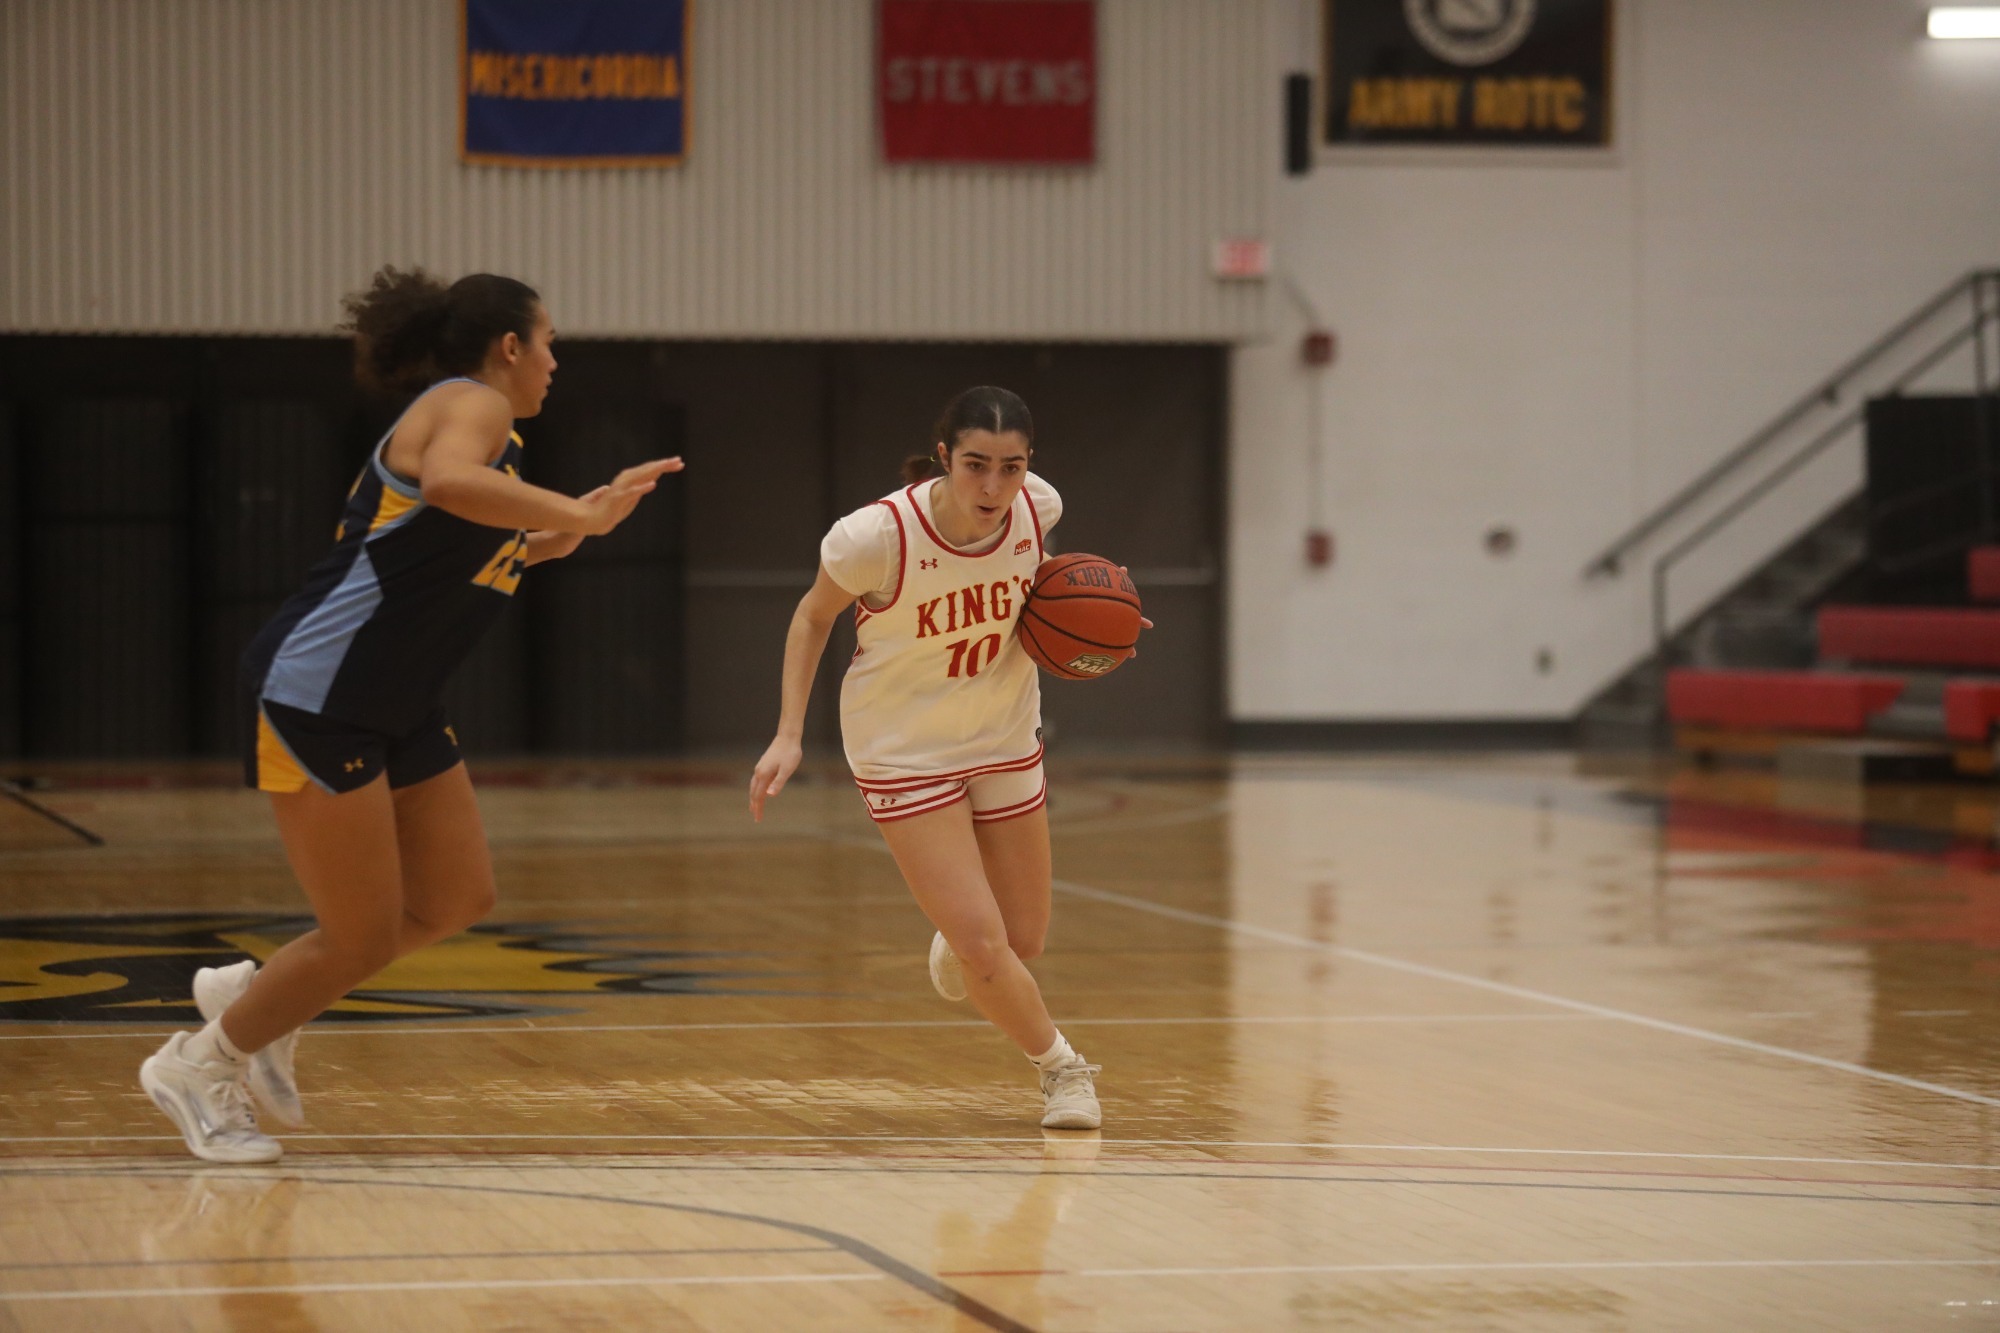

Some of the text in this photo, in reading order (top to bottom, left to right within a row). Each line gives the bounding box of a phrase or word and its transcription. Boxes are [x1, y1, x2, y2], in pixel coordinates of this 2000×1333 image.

[470, 54, 679, 98] MISERICORDIA
[886, 58, 1088, 106] STEVENS
[1349, 77, 1586, 131] ARMY ROTC
[1063, 566, 1112, 588] ROCK
[946, 633, 1002, 678] 10
